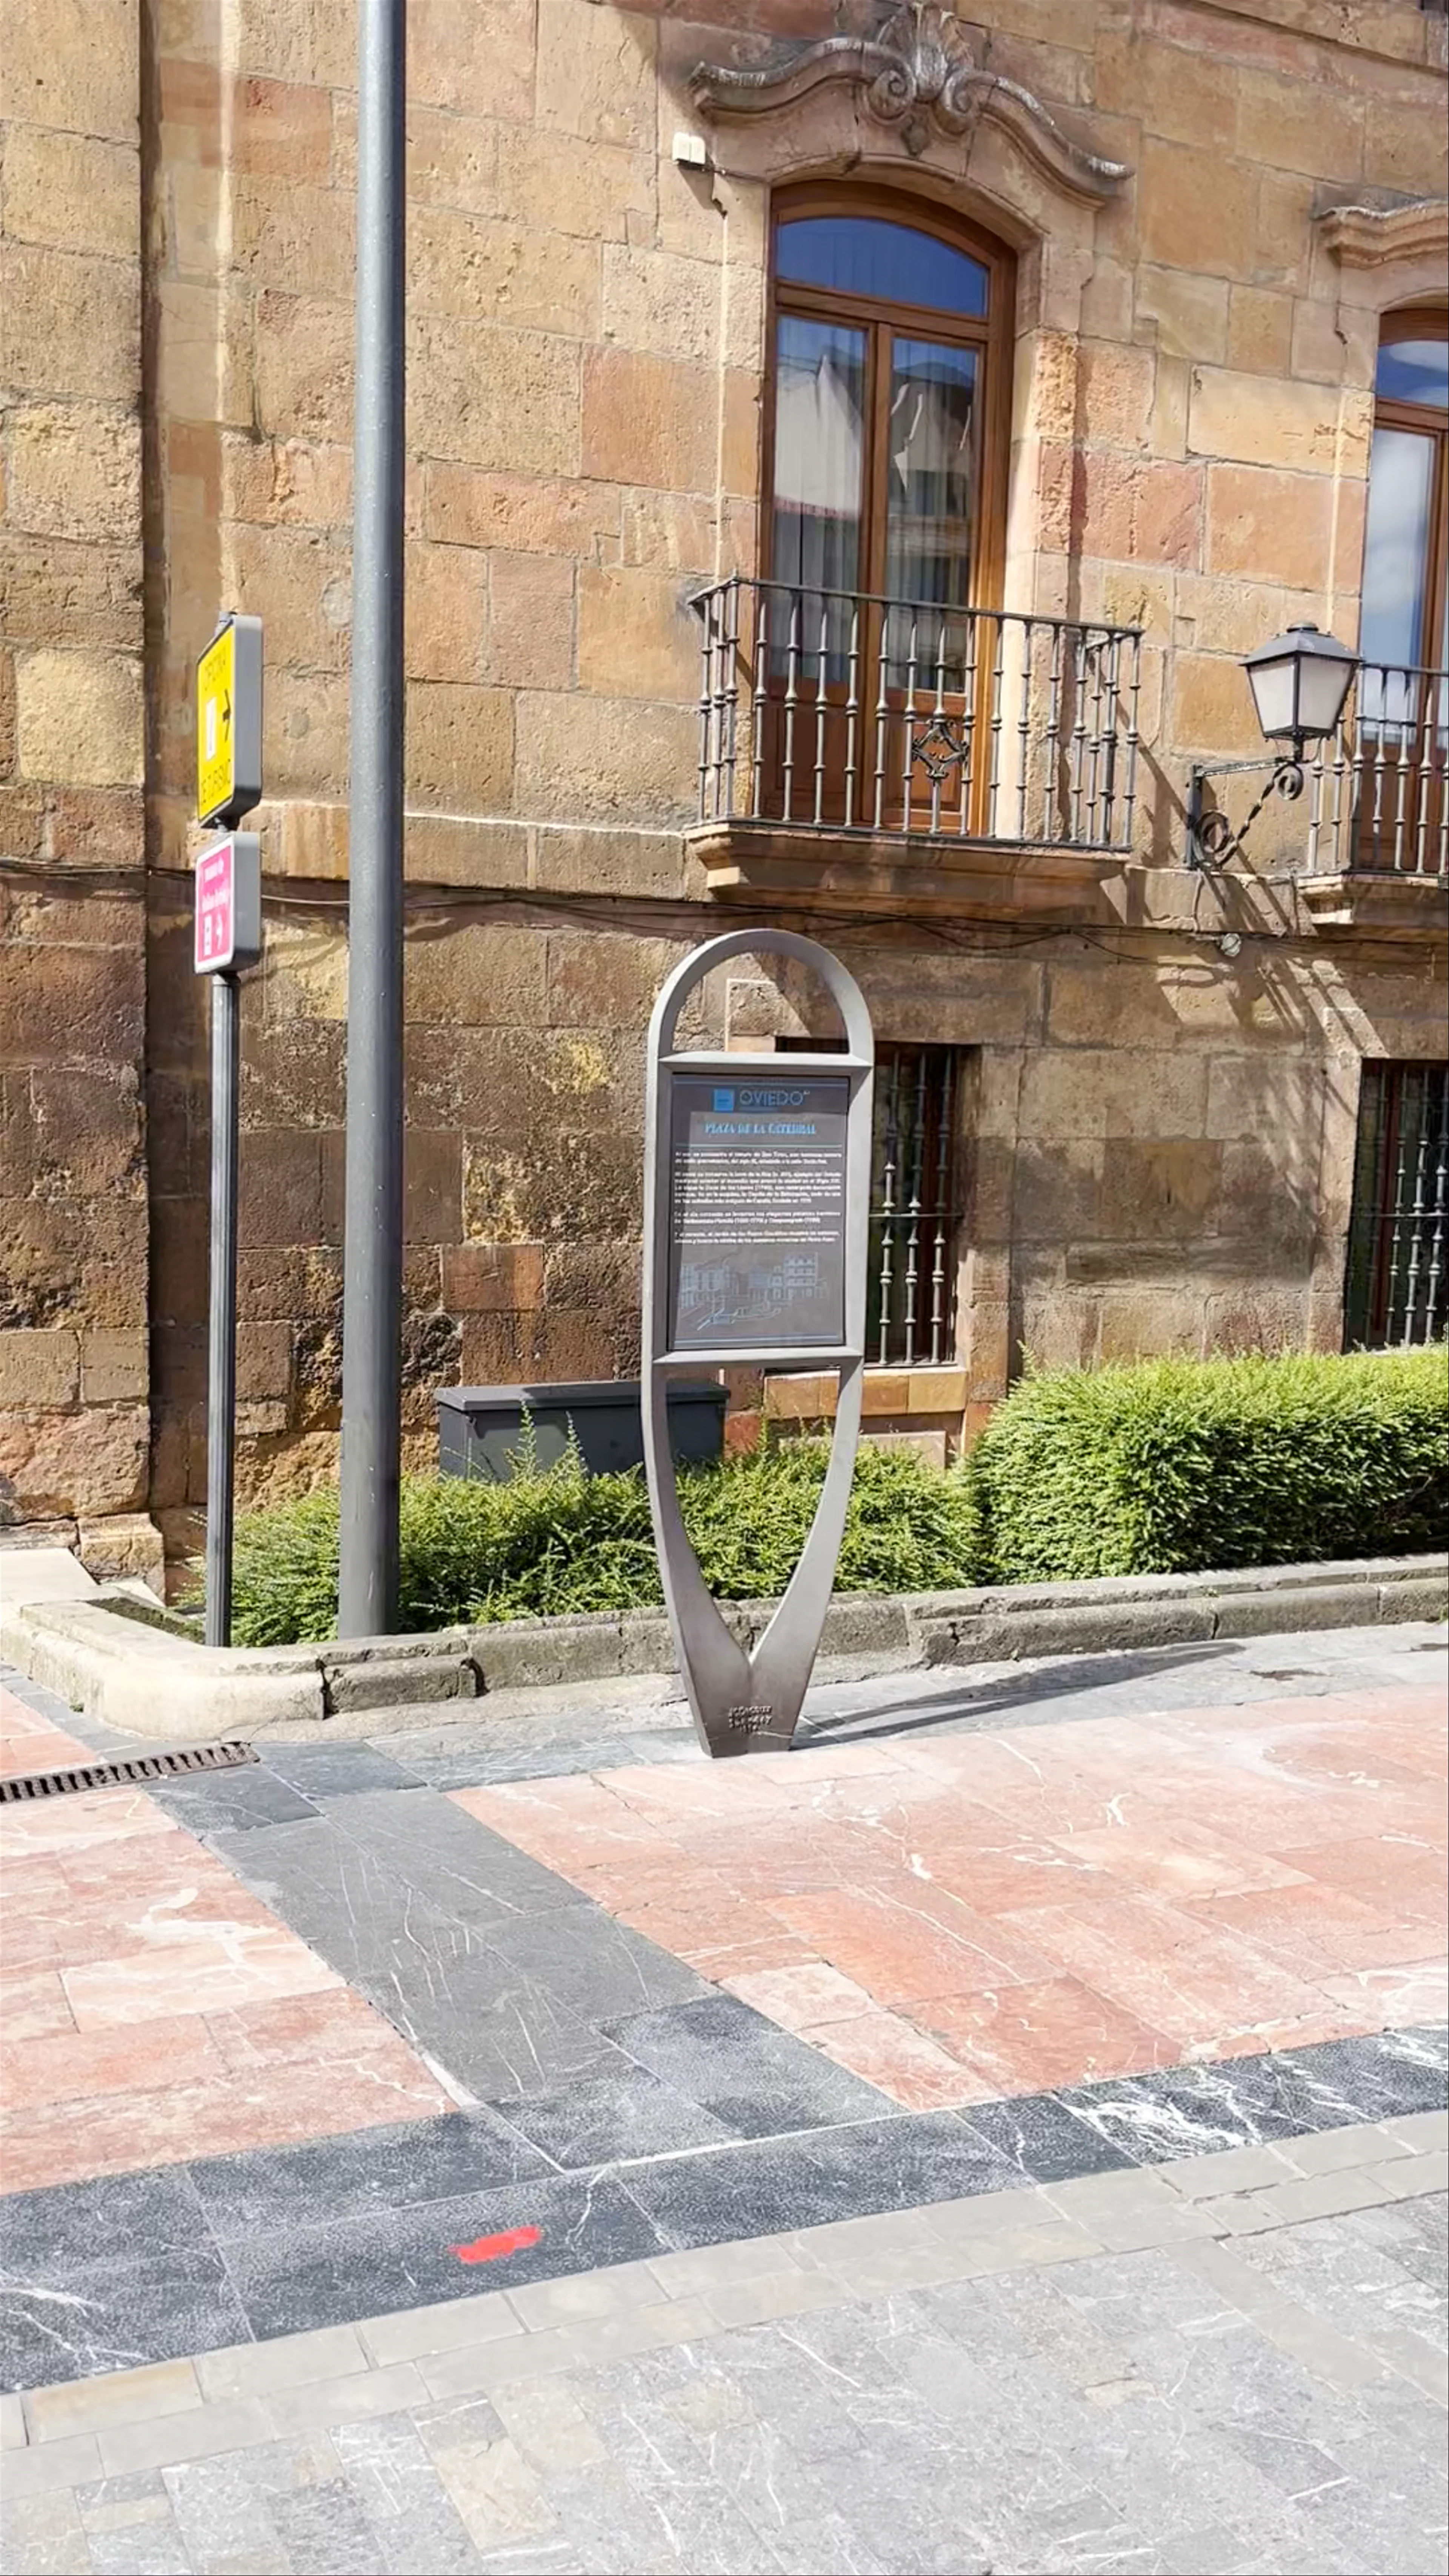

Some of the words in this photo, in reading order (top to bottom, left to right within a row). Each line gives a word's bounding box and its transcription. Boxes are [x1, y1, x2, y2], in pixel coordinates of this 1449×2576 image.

[739, 1089, 804, 1106] OVIEDO
[705, 1122, 735, 1134] PLAZA
[738, 1123, 750, 1134] DE
[754, 1123, 766, 1134] LA
[768, 1122, 816, 1134] CATEDRAL
